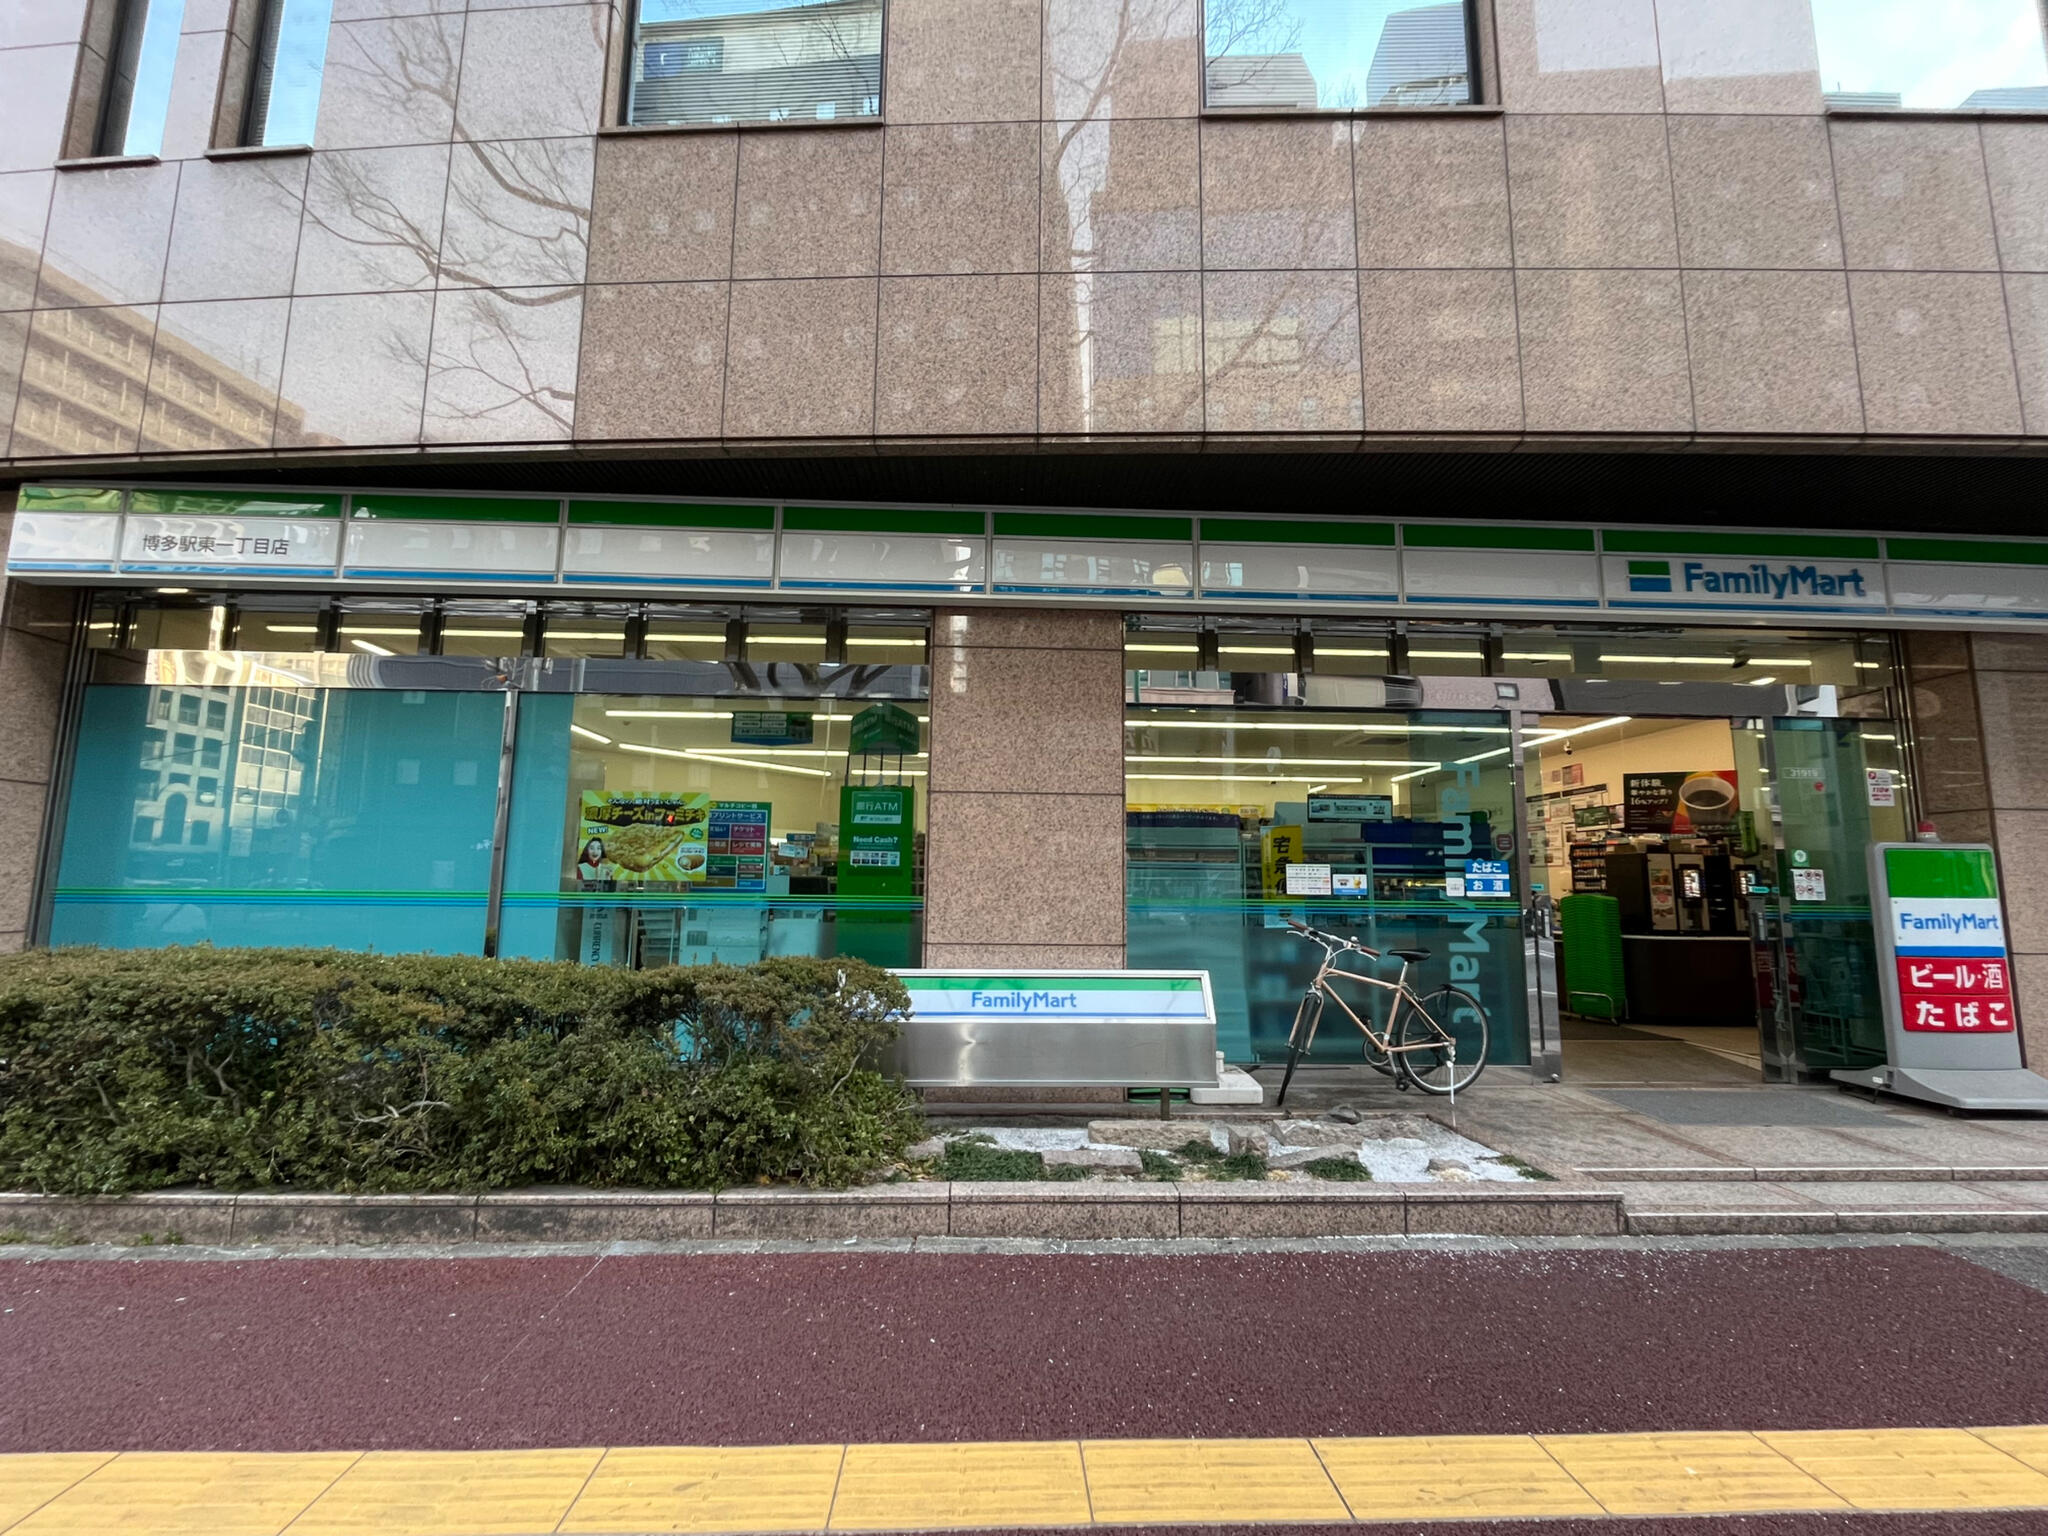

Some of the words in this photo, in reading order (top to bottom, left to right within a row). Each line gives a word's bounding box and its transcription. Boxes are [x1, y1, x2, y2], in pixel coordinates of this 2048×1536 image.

[143, 534, 290, 555] 博多駅東一丁目店
[1684, 561, 1867, 599] FamilyMart
[1471, 862, 1502, 873] たばこ
[1900, 913, 2000, 934] FamilyMart
[1910, 963, 2004, 990] ビール・酒
[971, 991, 1077, 1012] FamilyMart
[1915, 1000, 2009, 1027] たばこ
